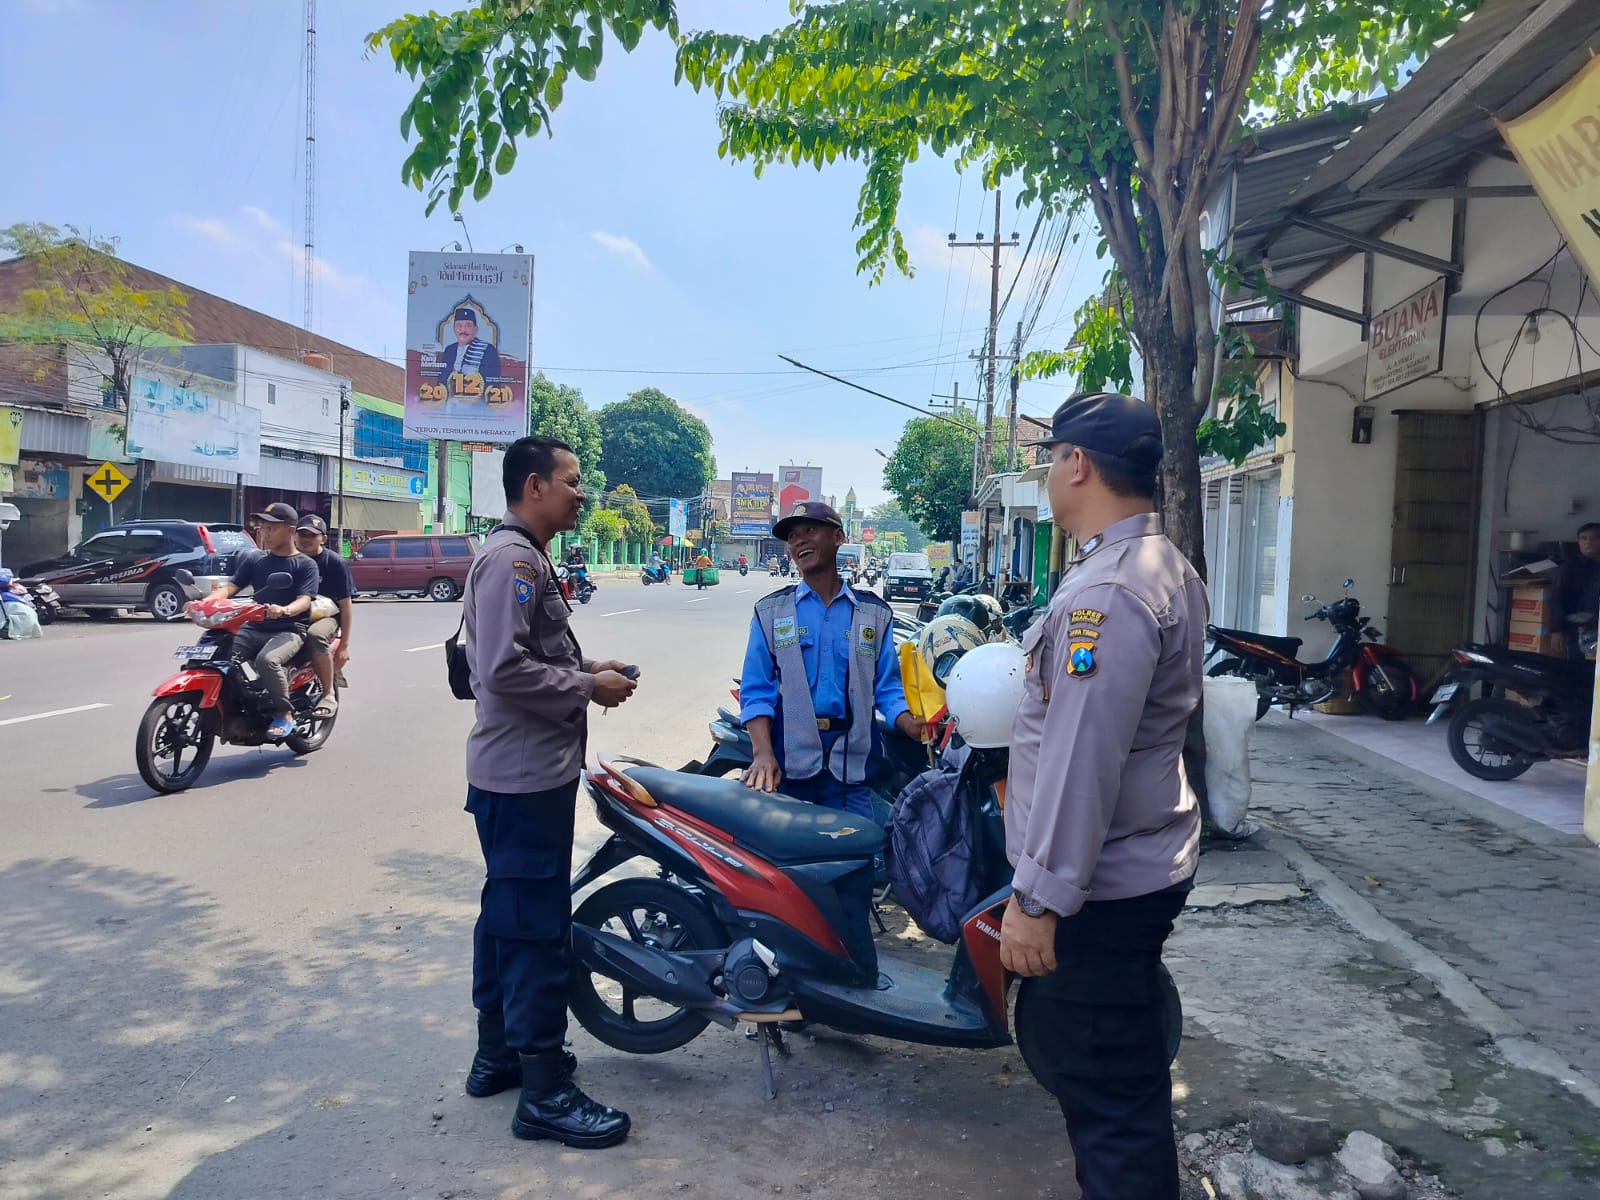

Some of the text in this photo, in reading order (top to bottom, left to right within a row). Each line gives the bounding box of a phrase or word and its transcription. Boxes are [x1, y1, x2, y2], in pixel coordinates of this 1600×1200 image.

[1372, 289, 1439, 349] BUANA
[1379, 327, 1426, 360] ELEKTRONIK
[422, 384, 445, 400] 20
[452, 372, 480, 395] 12
[489, 387, 509, 403] 21
[94, 567, 144, 584] TARUNA
[975, 919, 1001, 941] YAMAH
